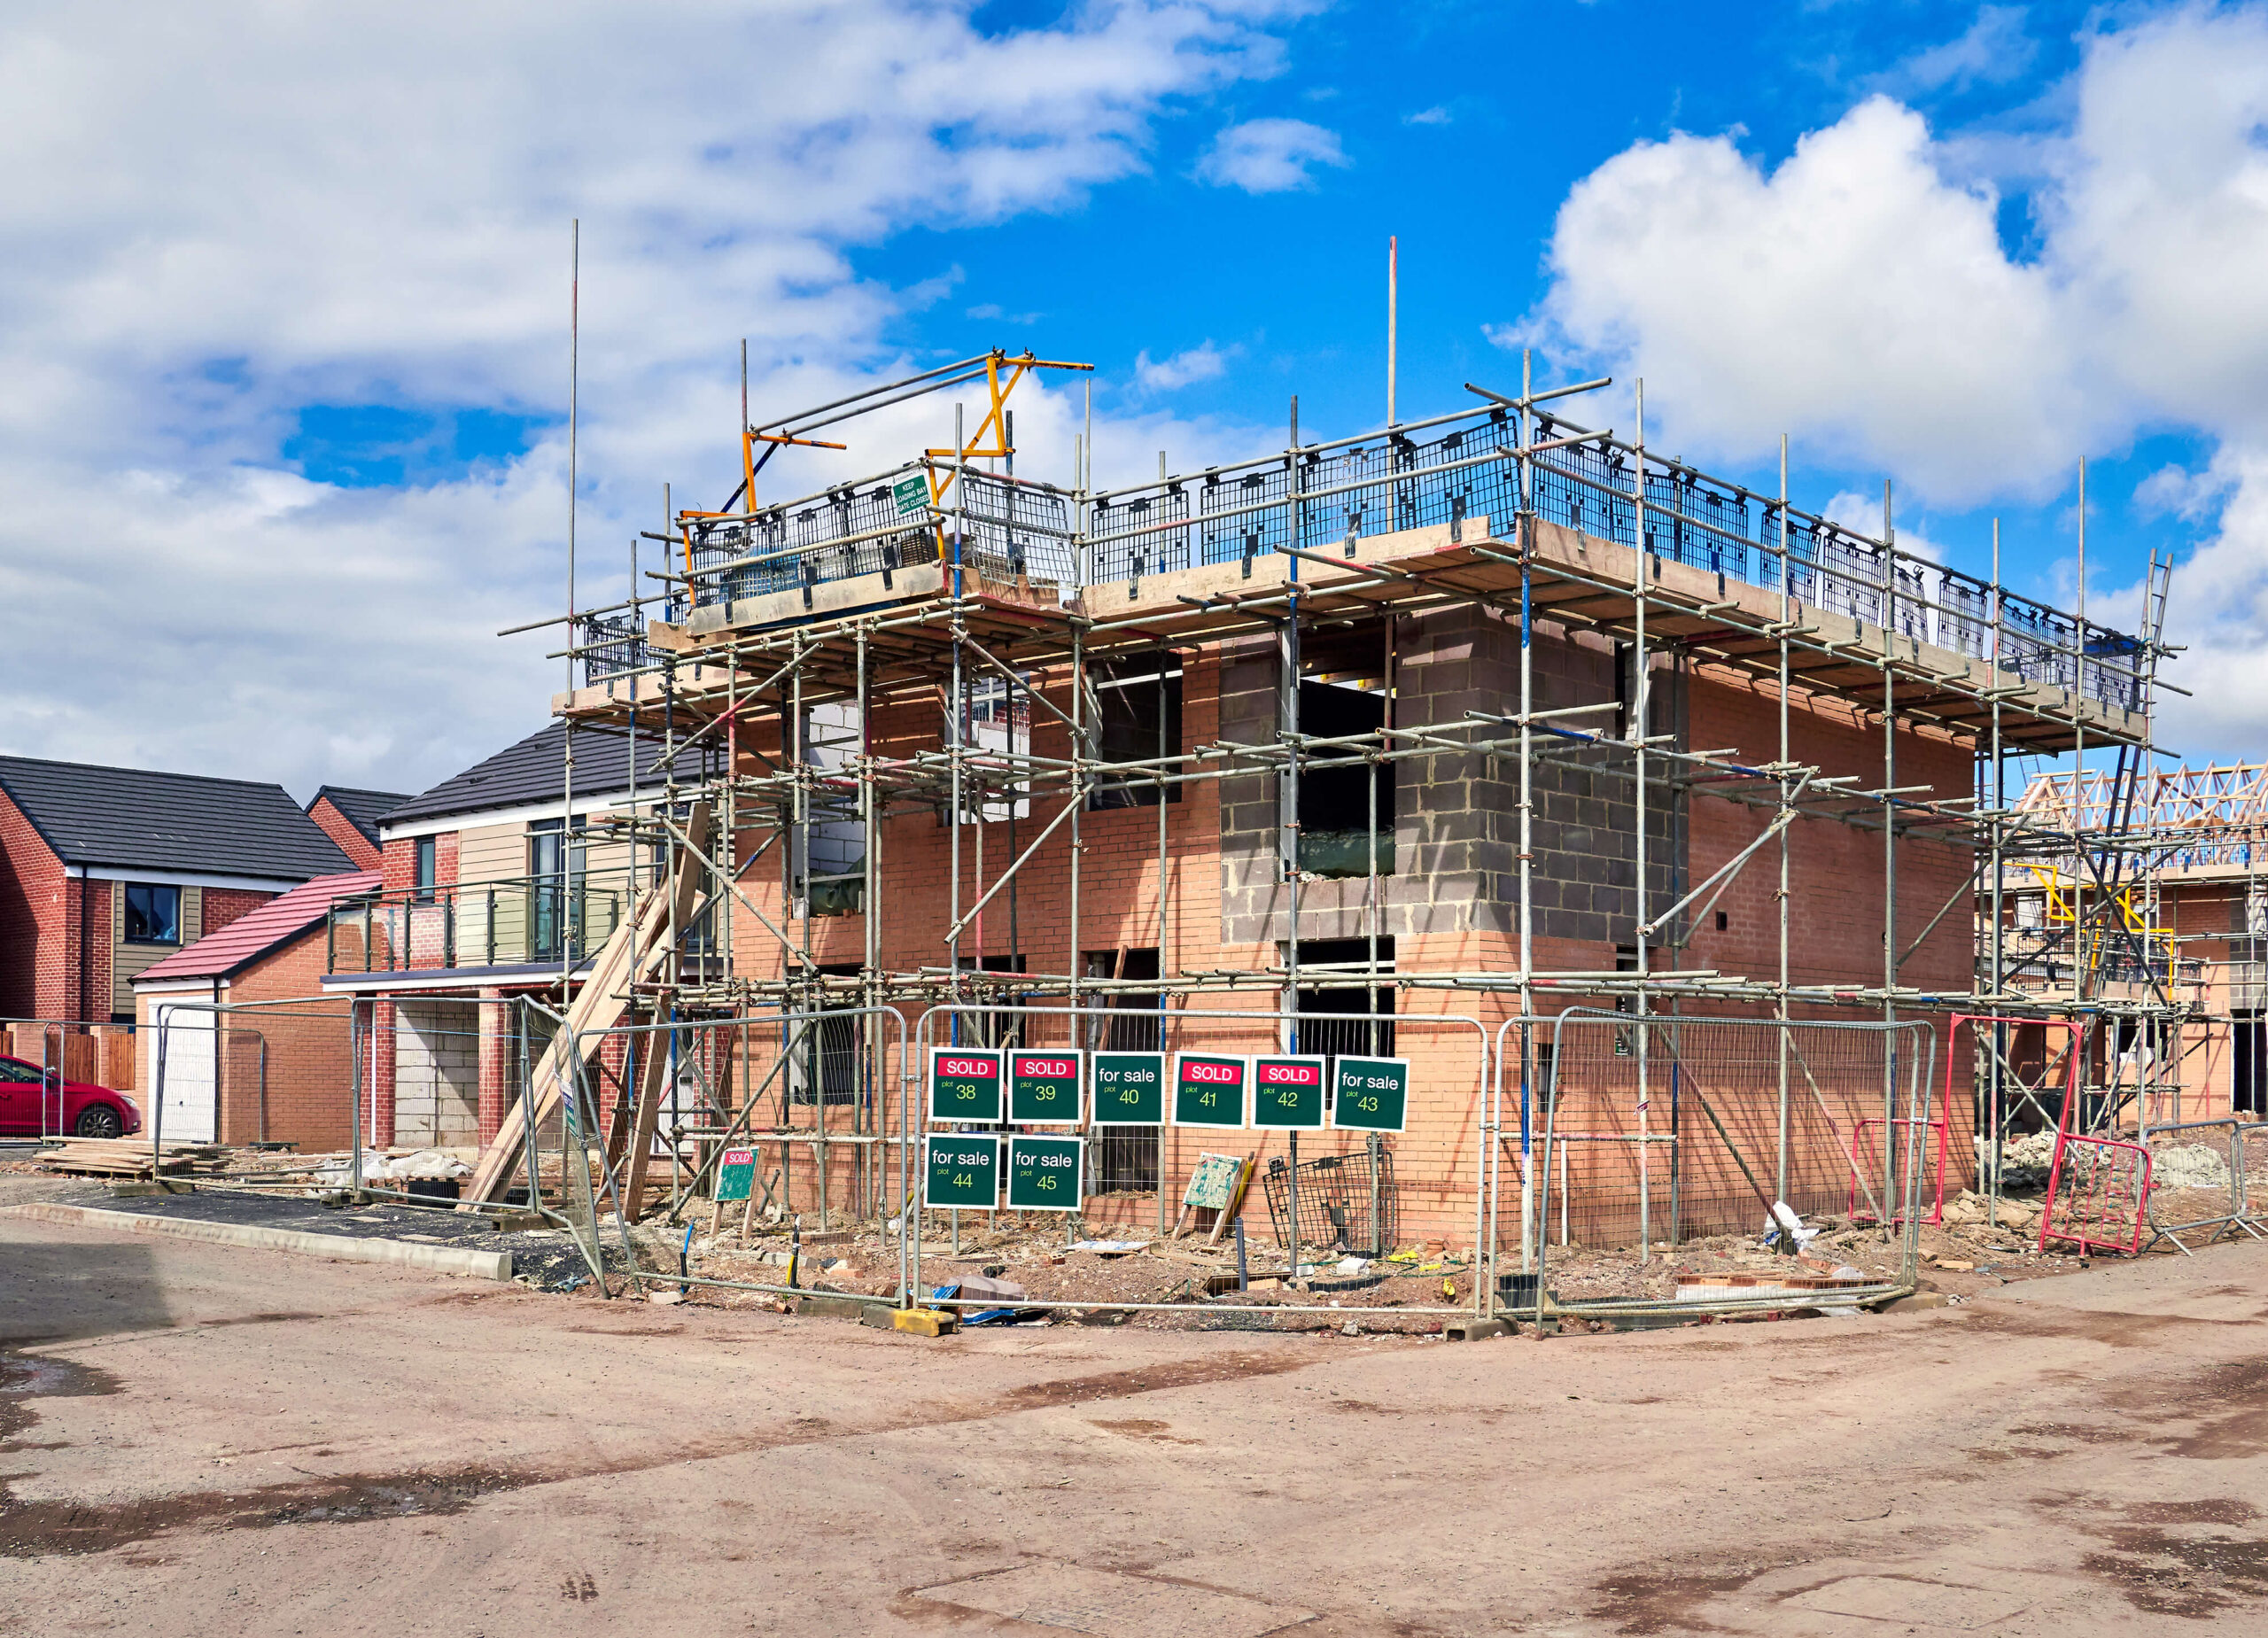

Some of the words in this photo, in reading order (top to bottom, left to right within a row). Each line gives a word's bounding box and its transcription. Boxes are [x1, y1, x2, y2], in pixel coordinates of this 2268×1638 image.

[902, 482, 914, 491] KEEP
[897, 491, 916, 503] LOADING
[916, 486, 927, 495] BAY
[897, 502, 910, 511] GATE
[910, 494, 929, 506] CLOSED
[947, 1061, 988, 1075] SOLD
[1026, 1062, 1066, 1075] SOLD
[1099, 1068, 1119, 1082] for
[1124, 1068, 1154, 1082] sale
[1192, 1066, 1232, 1081] SOLD
[1269, 1068, 1309, 1082] SOLD
[1342, 1073, 1363, 1086] for
[1367, 1076, 1398, 1090] sale
[957, 1085, 975, 1099] 38
[1036, 1085, 1055, 1100] 39
[1120, 1090, 1138, 1104] 40
[1200, 1092, 1216, 1106] 41
[1278, 1092, 1297, 1106] 42
[1357, 1097, 1378, 1112] 43
[729, 1153, 750, 1163] SOLD
[933, 1150, 953, 1163] for
[958, 1152, 989, 1165] sale
[1016, 1152, 1037, 1165] for
[1041, 1153, 1072, 1167] sale
[953, 1173, 973, 1187] 44
[1037, 1176, 1056, 1190] 45
